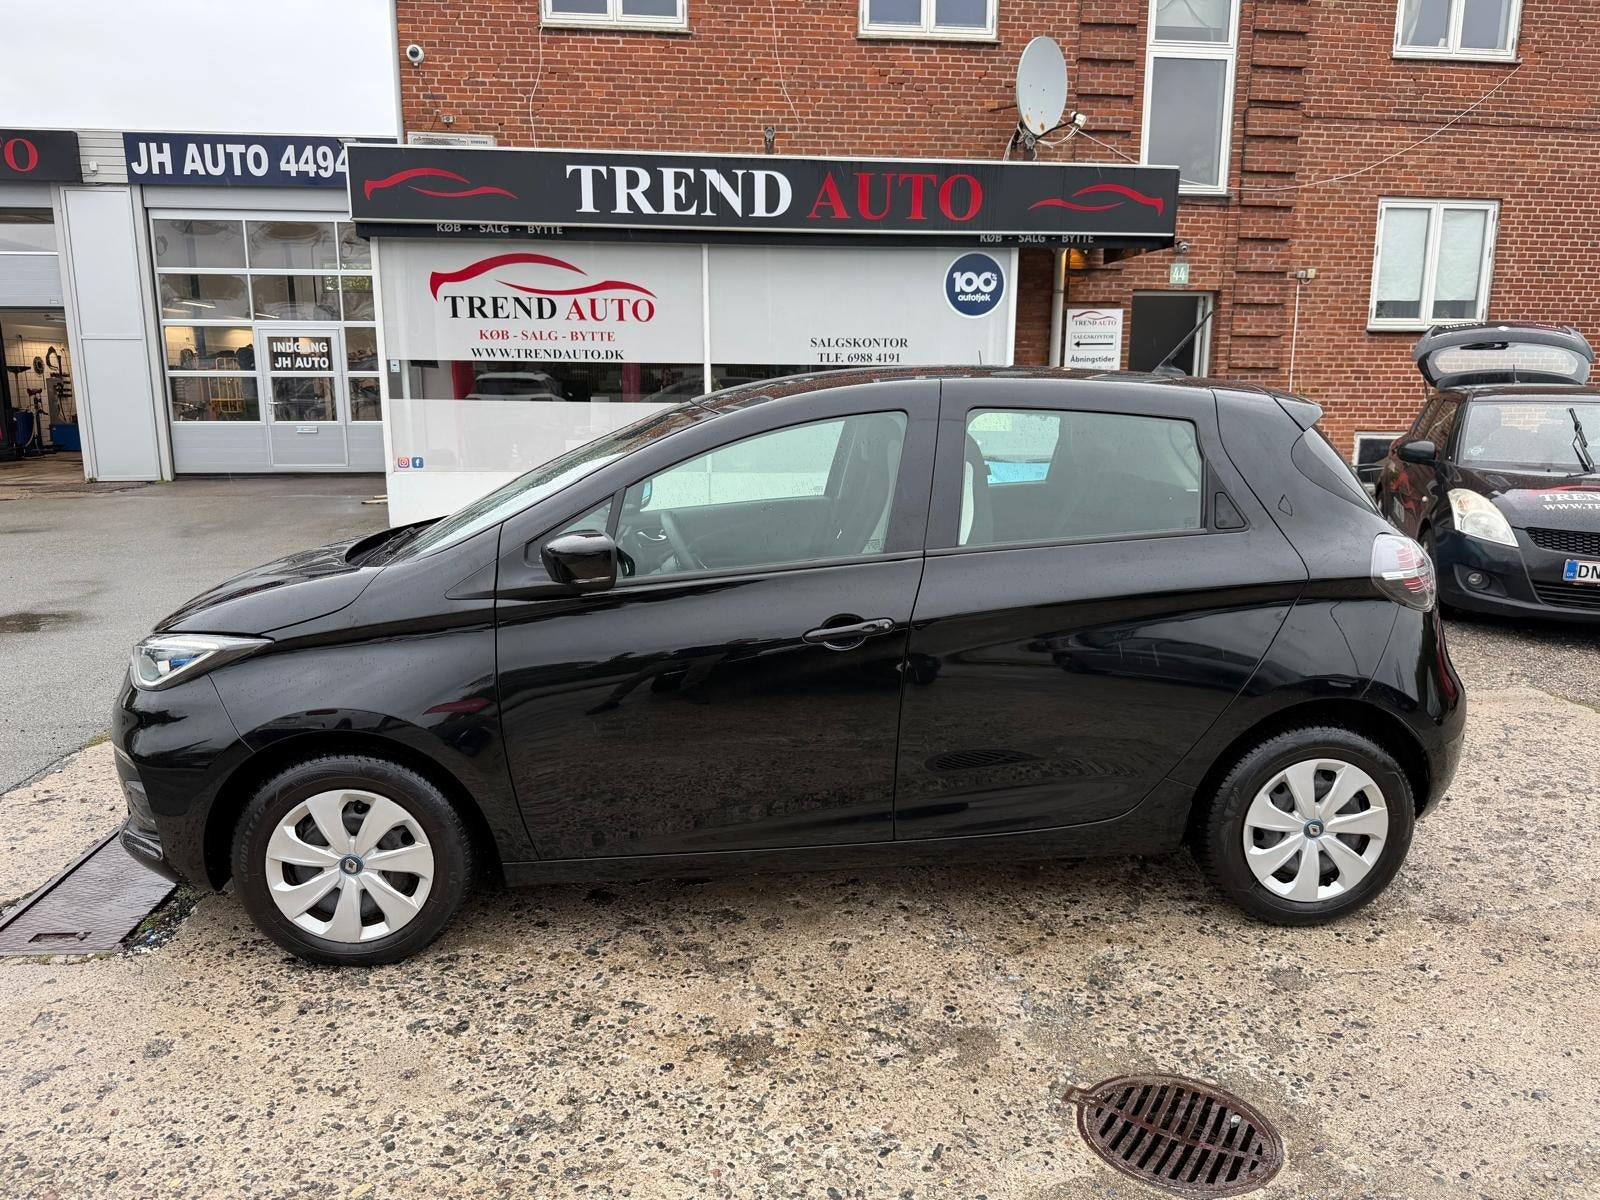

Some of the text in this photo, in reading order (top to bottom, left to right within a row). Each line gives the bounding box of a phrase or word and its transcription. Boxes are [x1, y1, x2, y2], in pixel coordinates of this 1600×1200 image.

[0, 138, 38, 172] O
[131, 142, 348, 178] JH AUTO 4494
[566, 165, 983, 222] TREND AUTO
[436, 223, 462, 232] KØB
[479, 224, 509, 233] SALG
[528, 225, 563, 234] BYTTE
[1018, 234, 1046, 243] SALG
[1173, 267, 1185, 281] 44
[957, 293, 991, 303] autotjek
[444, 295, 655, 323] TREND AUTO
[479, 329, 509, 341] KØB
[521, 330, 558, 342] SALG
[570, 331, 616, 342] BYTTE
[272, 342, 328, 353] INDGANG
[810, 337, 908, 348] SALGSKONTOR
[471, 347, 624, 360] WWW.TRENDAUTO.DK
[817, 352, 900, 363] TLF. 6988 4191
[274, 357, 329, 368] JH AUTO
[1070, 355, 1115, 364] Åbningstider
